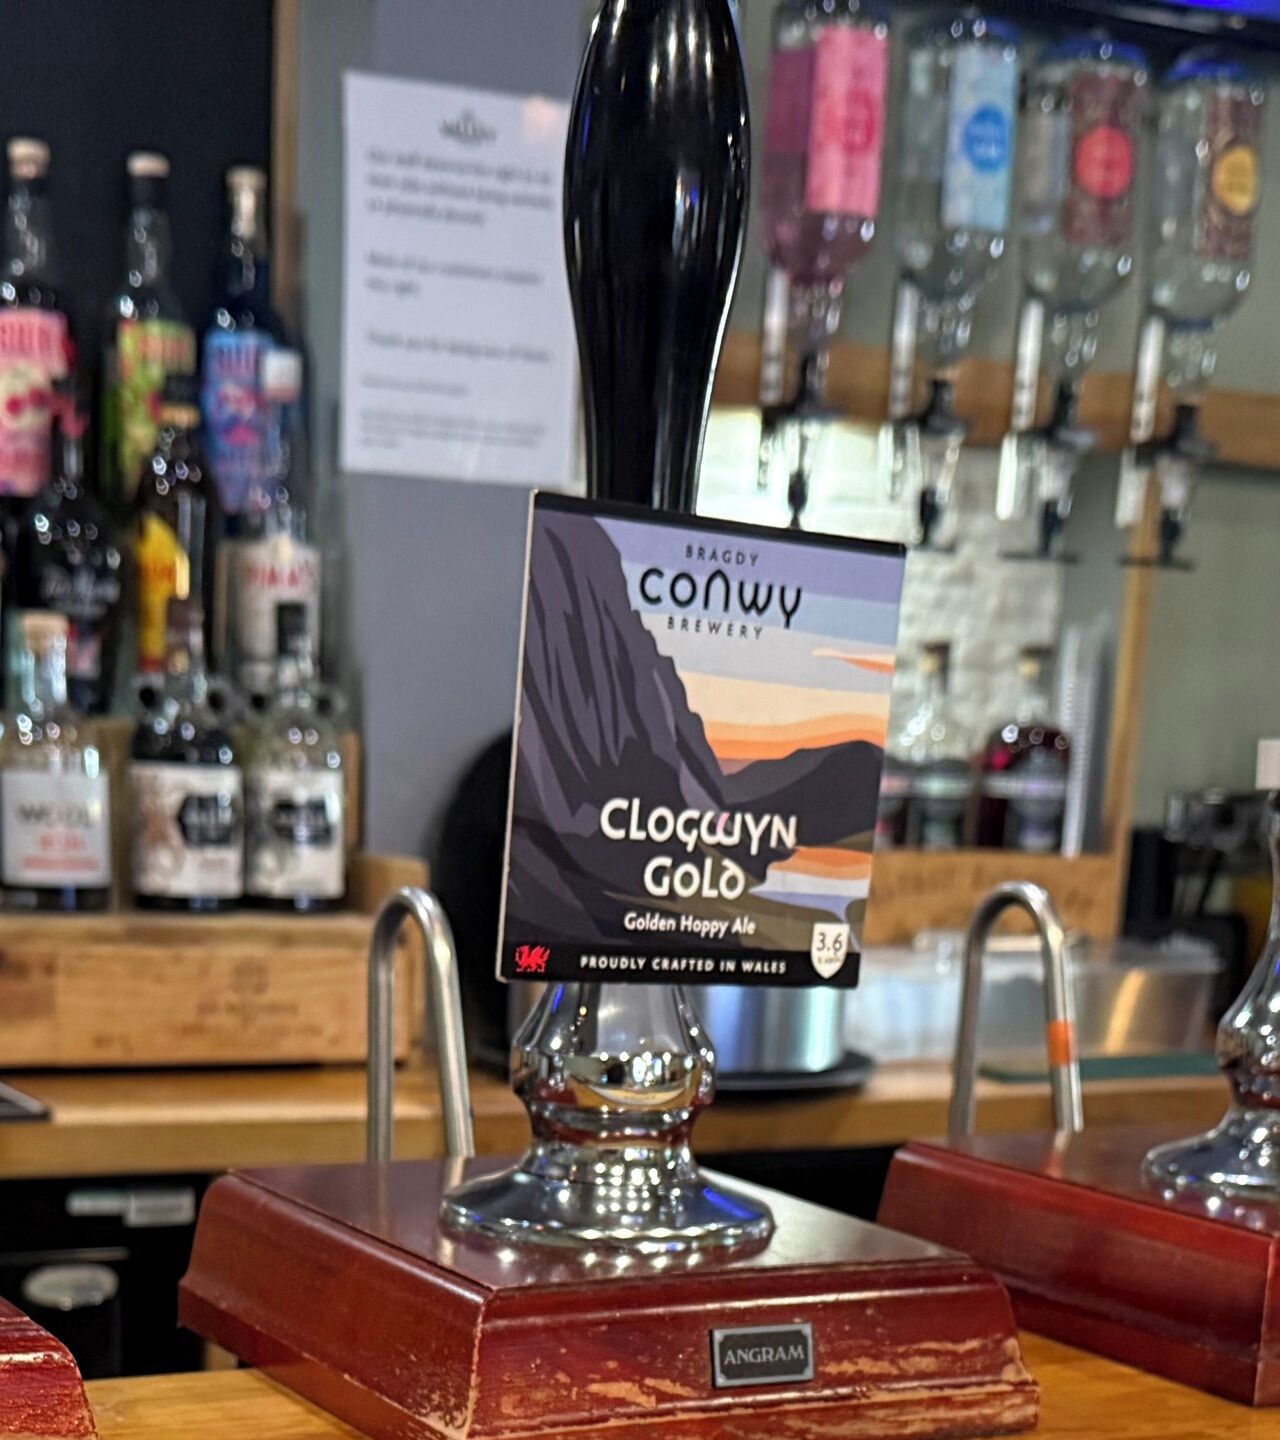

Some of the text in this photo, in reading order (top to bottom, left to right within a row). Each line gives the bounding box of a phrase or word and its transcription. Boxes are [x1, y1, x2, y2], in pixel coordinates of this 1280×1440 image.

[685, 544, 760, 567] BRAGDY
[639, 567, 802, 629] CONWY
[667, 616, 763, 640] BREWERY
[624, 912, 756, 937] Golden Hoppy Ale
[816, 932, 843, 952] 3.6
[580, 954, 786, 975] PROUDLY CRAFTED IN WALES
[724, 1345, 805, 1365] ANGRAM
